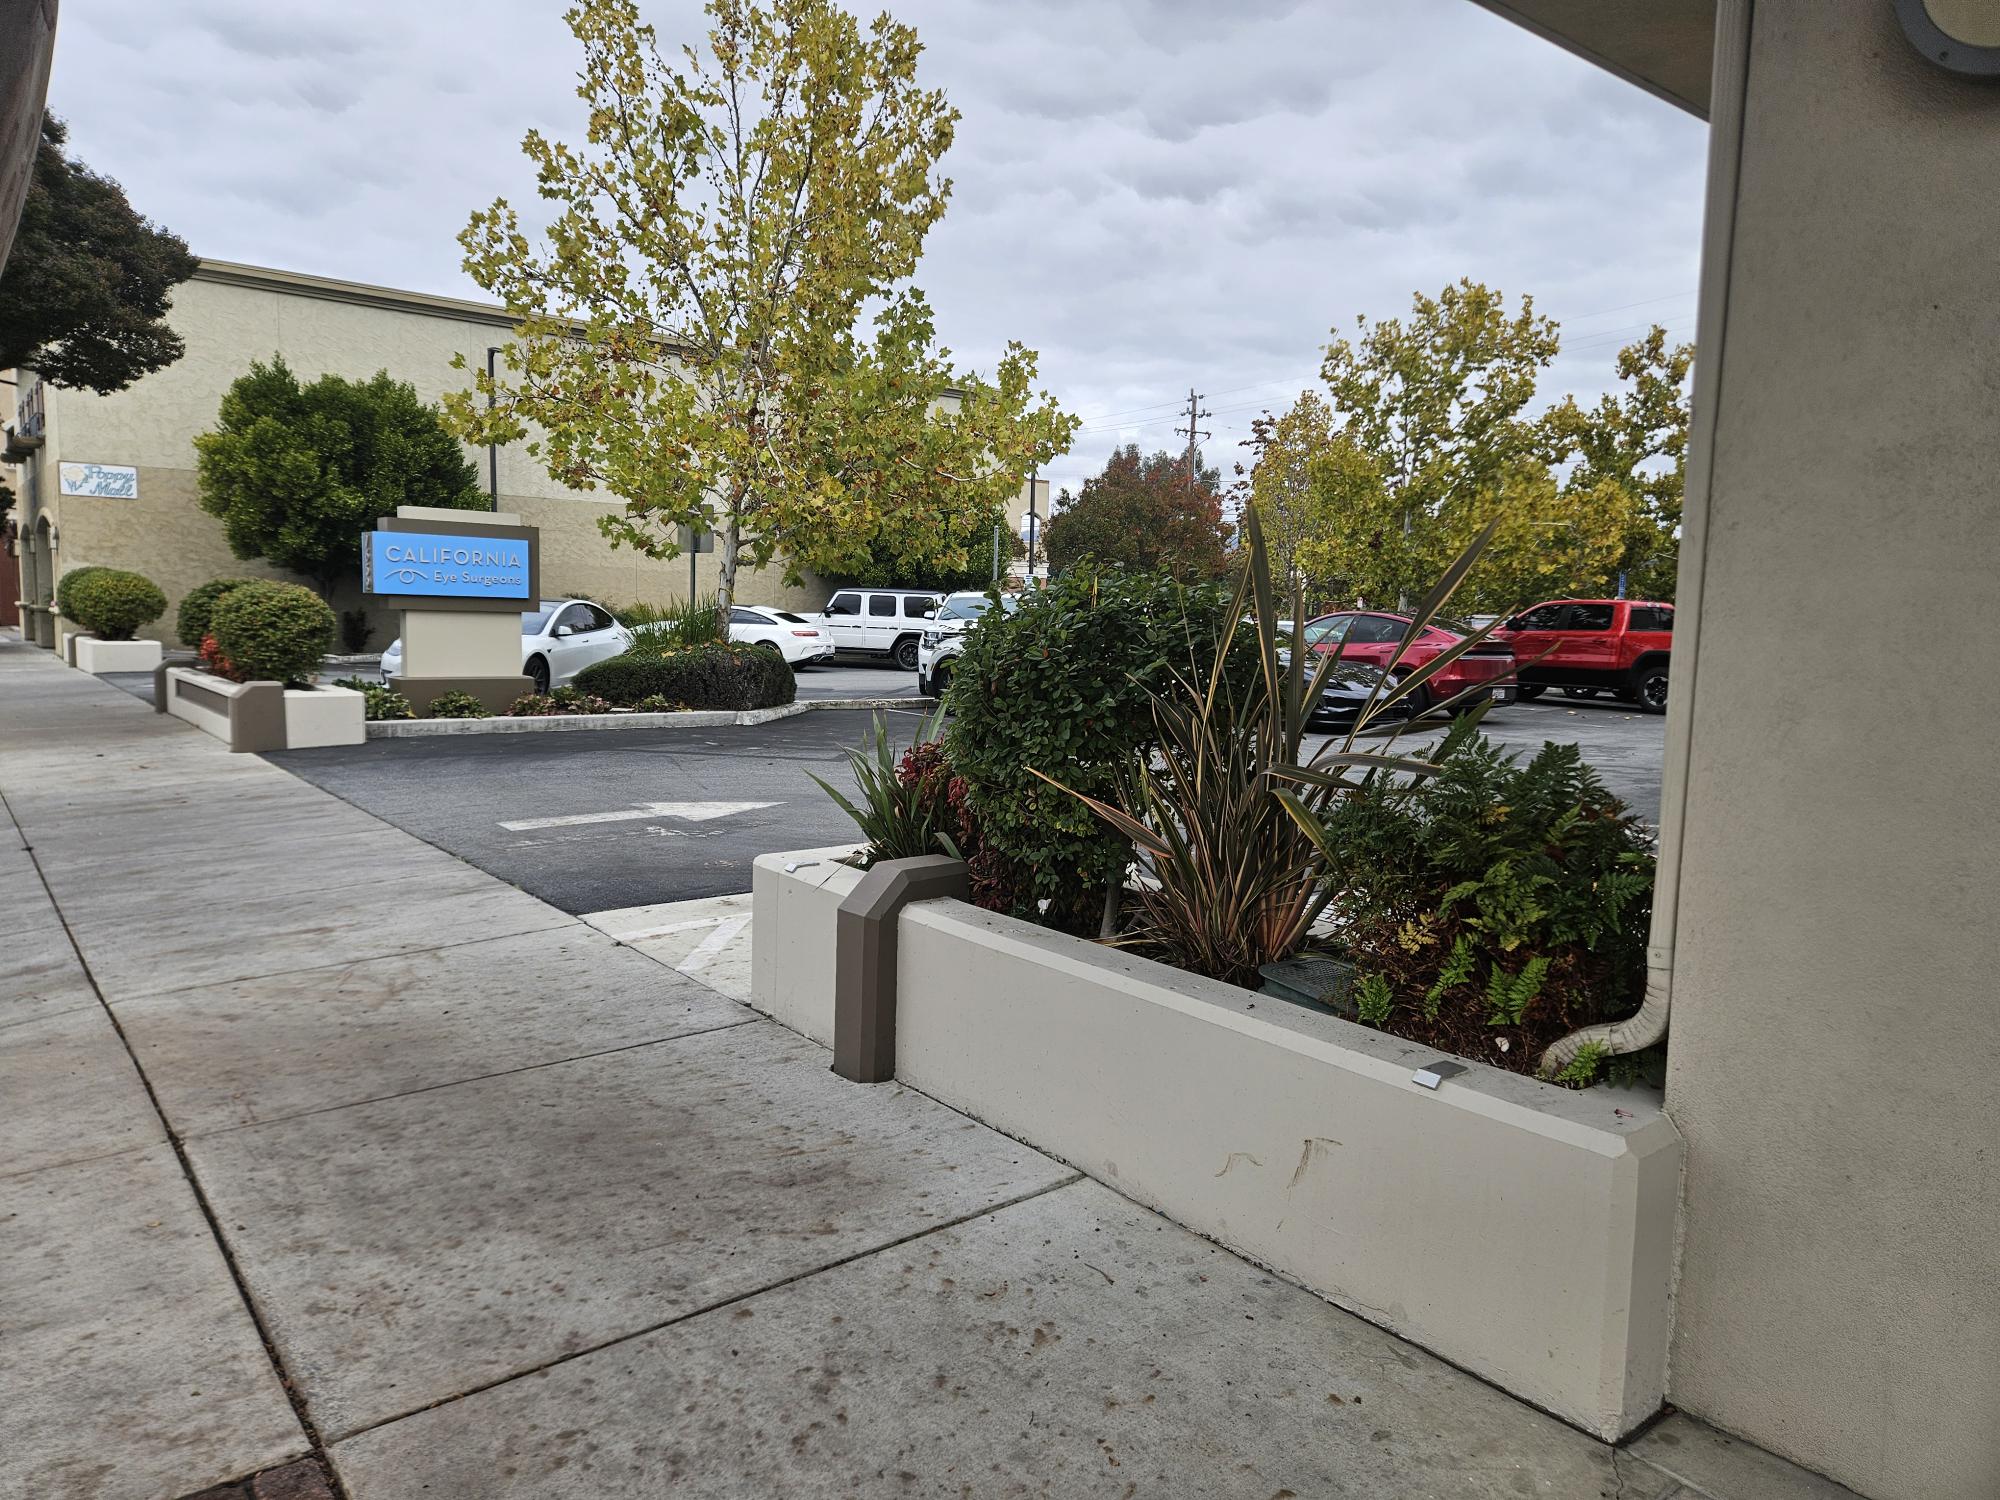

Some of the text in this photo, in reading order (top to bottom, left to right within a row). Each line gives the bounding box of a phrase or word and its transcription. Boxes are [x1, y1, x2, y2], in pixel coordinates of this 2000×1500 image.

[84, 464, 135, 483] Poppy
[89, 480, 134, 496] Mall
[385, 545, 521, 568] CALIFORNIA
[433, 570, 521, 587] Eye Surgeons
